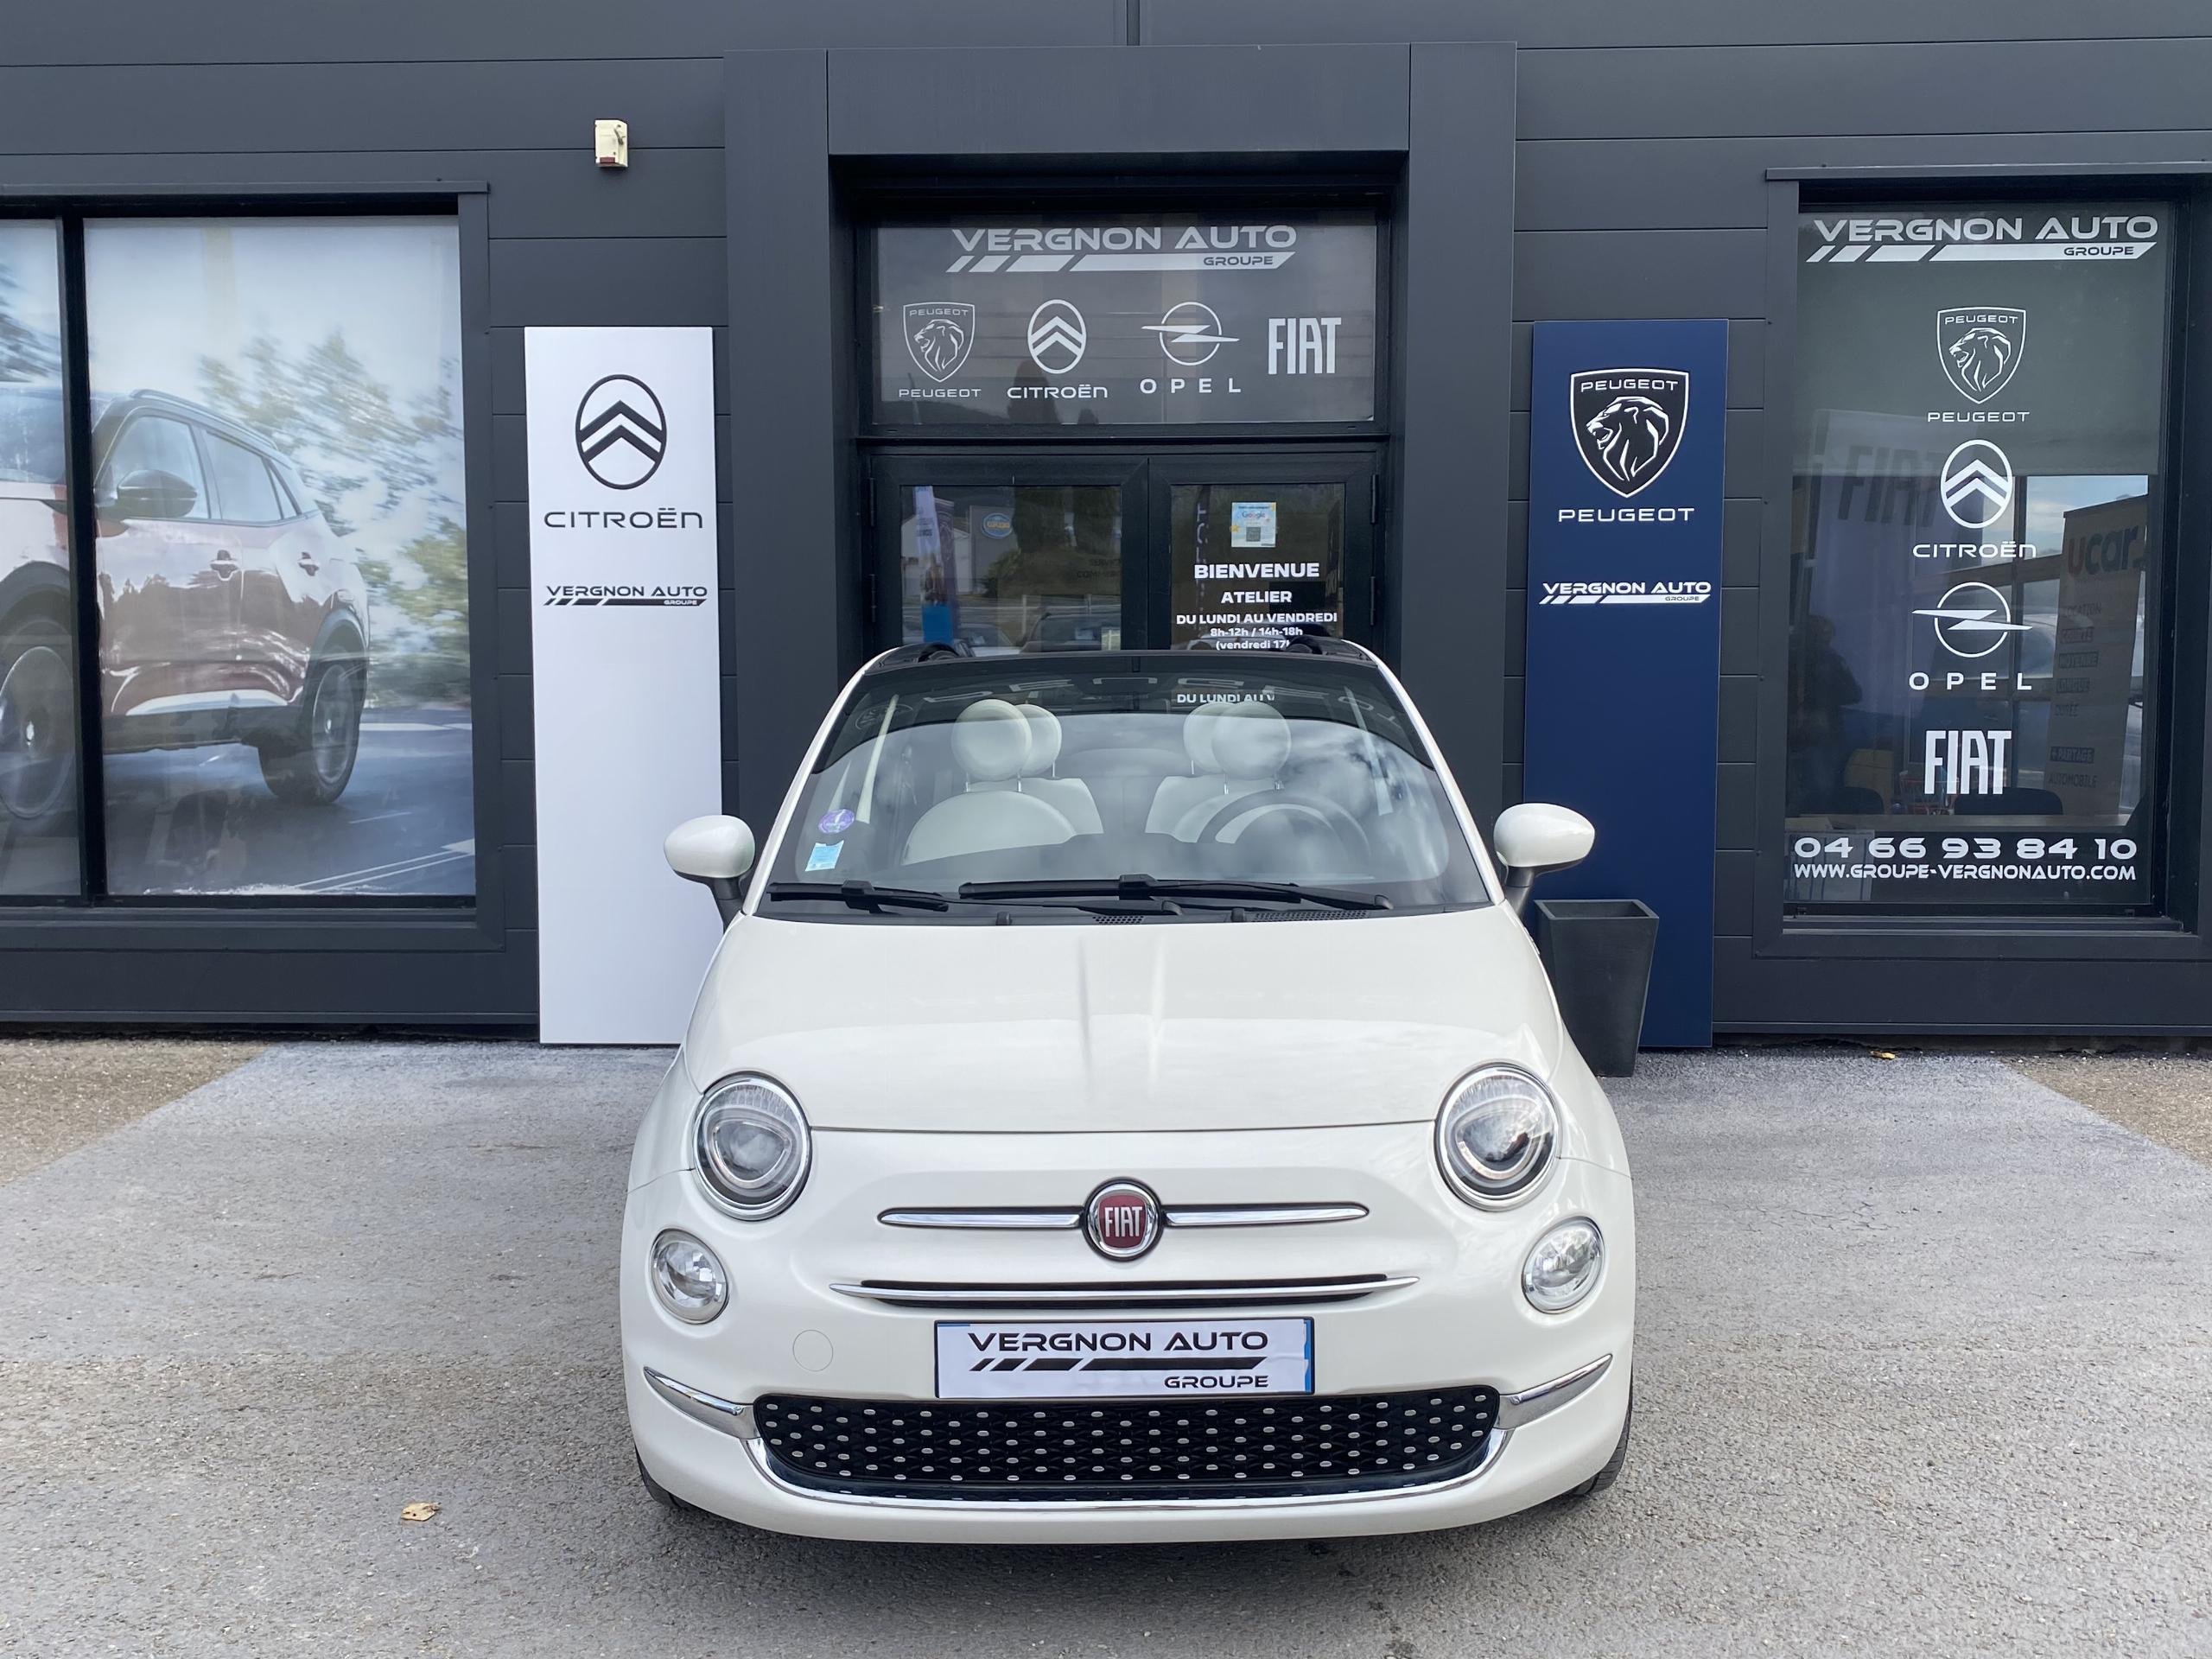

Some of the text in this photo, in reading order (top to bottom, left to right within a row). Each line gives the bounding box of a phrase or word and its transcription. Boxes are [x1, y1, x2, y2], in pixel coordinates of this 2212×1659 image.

[1814, 215, 2158, 243] VERGNON AUTO
[951, 225, 1297, 251] VERGNON AUTO
[2063, 246, 2134, 257] GROUPE
[1203, 256, 1274, 268] GROUPE
[909, 308, 969, 318] PEUGEOT
[1944, 315, 2018, 326] PEUGEOT
[1268, 317, 1342, 375] FIAT
[1140, 377, 1242, 395] OPEL
[1580, 378, 1679, 393] PEUGEOT
[899, 388, 982, 398] PEUGEOT
[1927, 410, 2031, 423] PEUGEOT
[1558, 507, 1695, 523] PEUGEOT
[1194, 563, 1320, 579] BIENVENUE
[546, 586, 708, 597] VERGNON AUTO
[1542, 582, 1712, 594] VERGNON AUTO
[1221, 591, 1293, 604] ATELIER
[1176, 612, 1338, 625] DU LUNDI AU VENDREDI
[1210, 626, 1304, 638] 8h-12h / 14h-18h
[1216, 639, 1272, 652] (vendredi
[1908, 671, 2032, 691] OPEL
[1177, 693, 1197, 703] DU
[1199, 693, 1241, 703] LUNDI
[1923, 729, 2012, 795] FIAT
[1794, 837, 2137, 861] 04 66 93 84 10
[1793, 863, 2137, 880] WWW.GROUPE-VERGNONAUTO.COM
[1104, 1205, 1143, 1237] FIAT
[968, 1331, 1269, 1352] VERGNON AUTO
[1163, 1375, 1269, 1389] GROUPE
